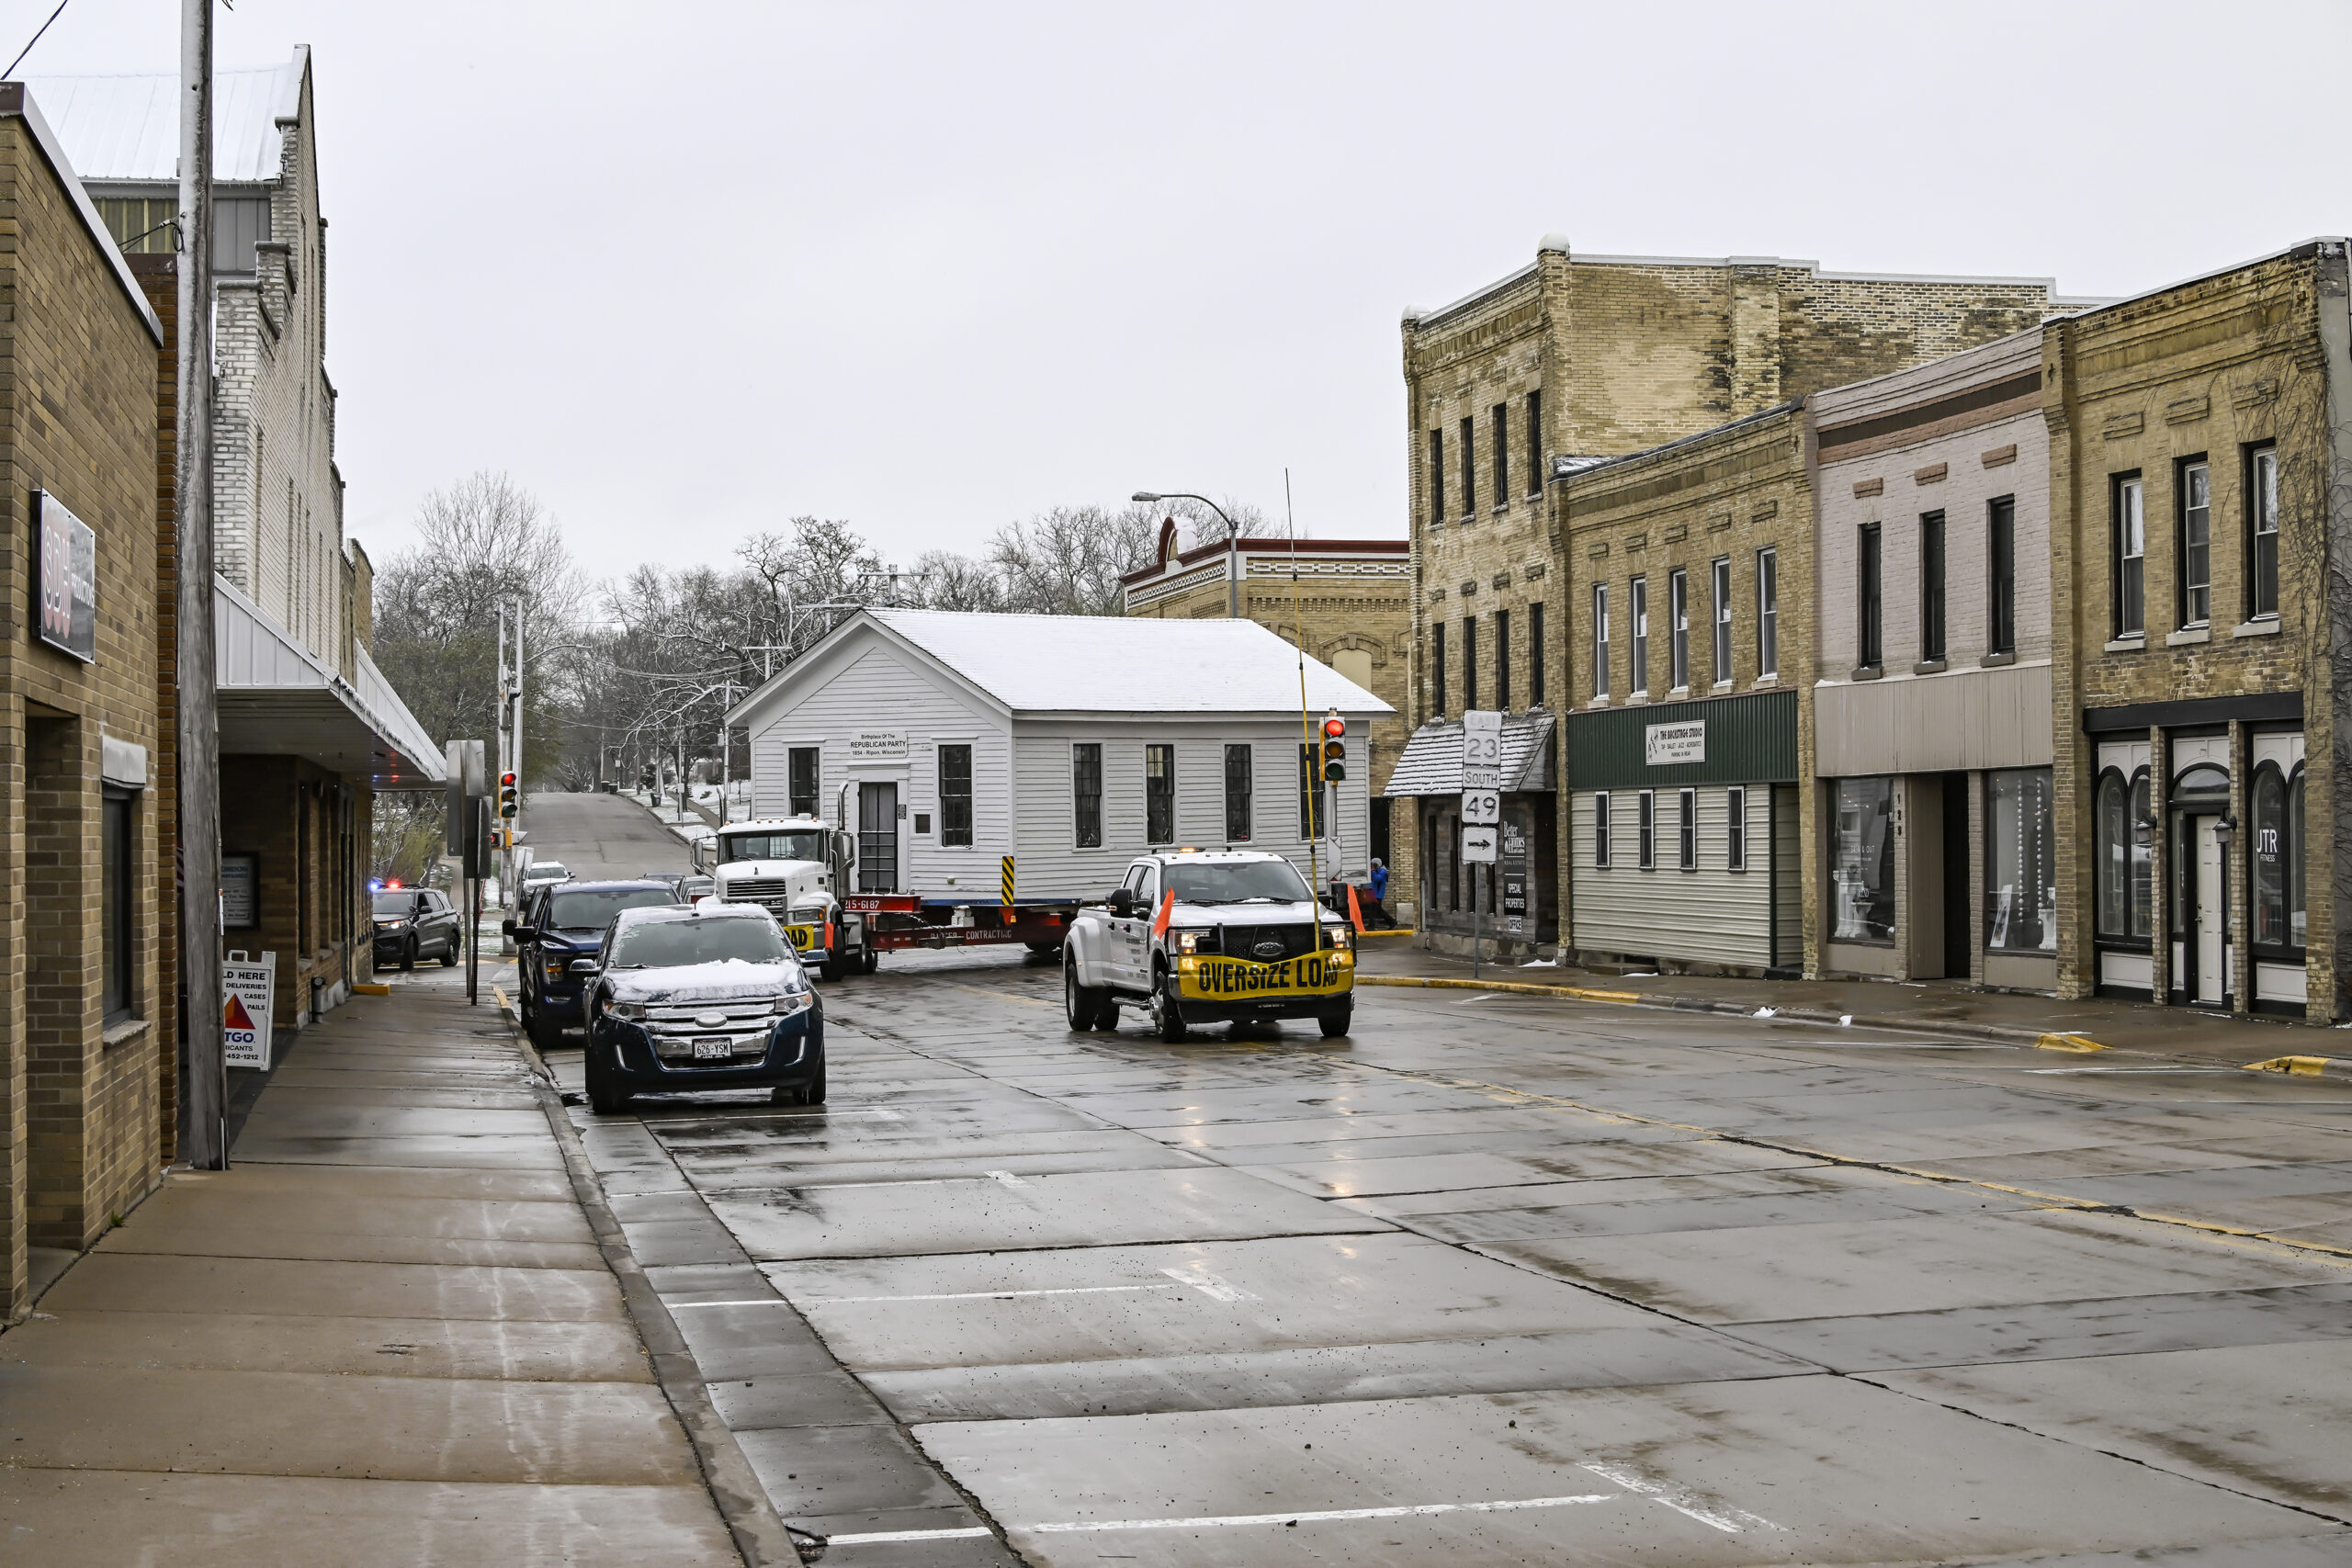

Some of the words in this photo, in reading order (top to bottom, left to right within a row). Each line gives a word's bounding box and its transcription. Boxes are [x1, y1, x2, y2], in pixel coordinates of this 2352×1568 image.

[1470, 715, 1497, 726] EAST
[1668, 728, 1688, 739] BACKSTAGE
[1690, 728, 1702, 738] STUDIO
[1467, 739, 1498, 758] 23
[1464, 771, 1498, 784] SOUTH
[1465, 796, 1497, 817] 49
[1504, 821, 1518, 837] Better
[1508, 836, 1525, 853] Homes
[2256, 829, 2278, 853] JTR
[2260, 854, 2276, 863] FITNESS
[1508, 883, 1521, 894] SPECIAL
[1505, 897, 1525, 908] PROPERTIES
[1509, 919, 1521, 931] OFFICE
[966, 929, 1012, 940] CONTRACTING
[239, 972, 266, 980] HERE
[1198, 961, 1290, 993] OVERSIZE
[1296, 957, 1339, 988] LOAD
[696, 1043, 729, 1055] 626-YSM
